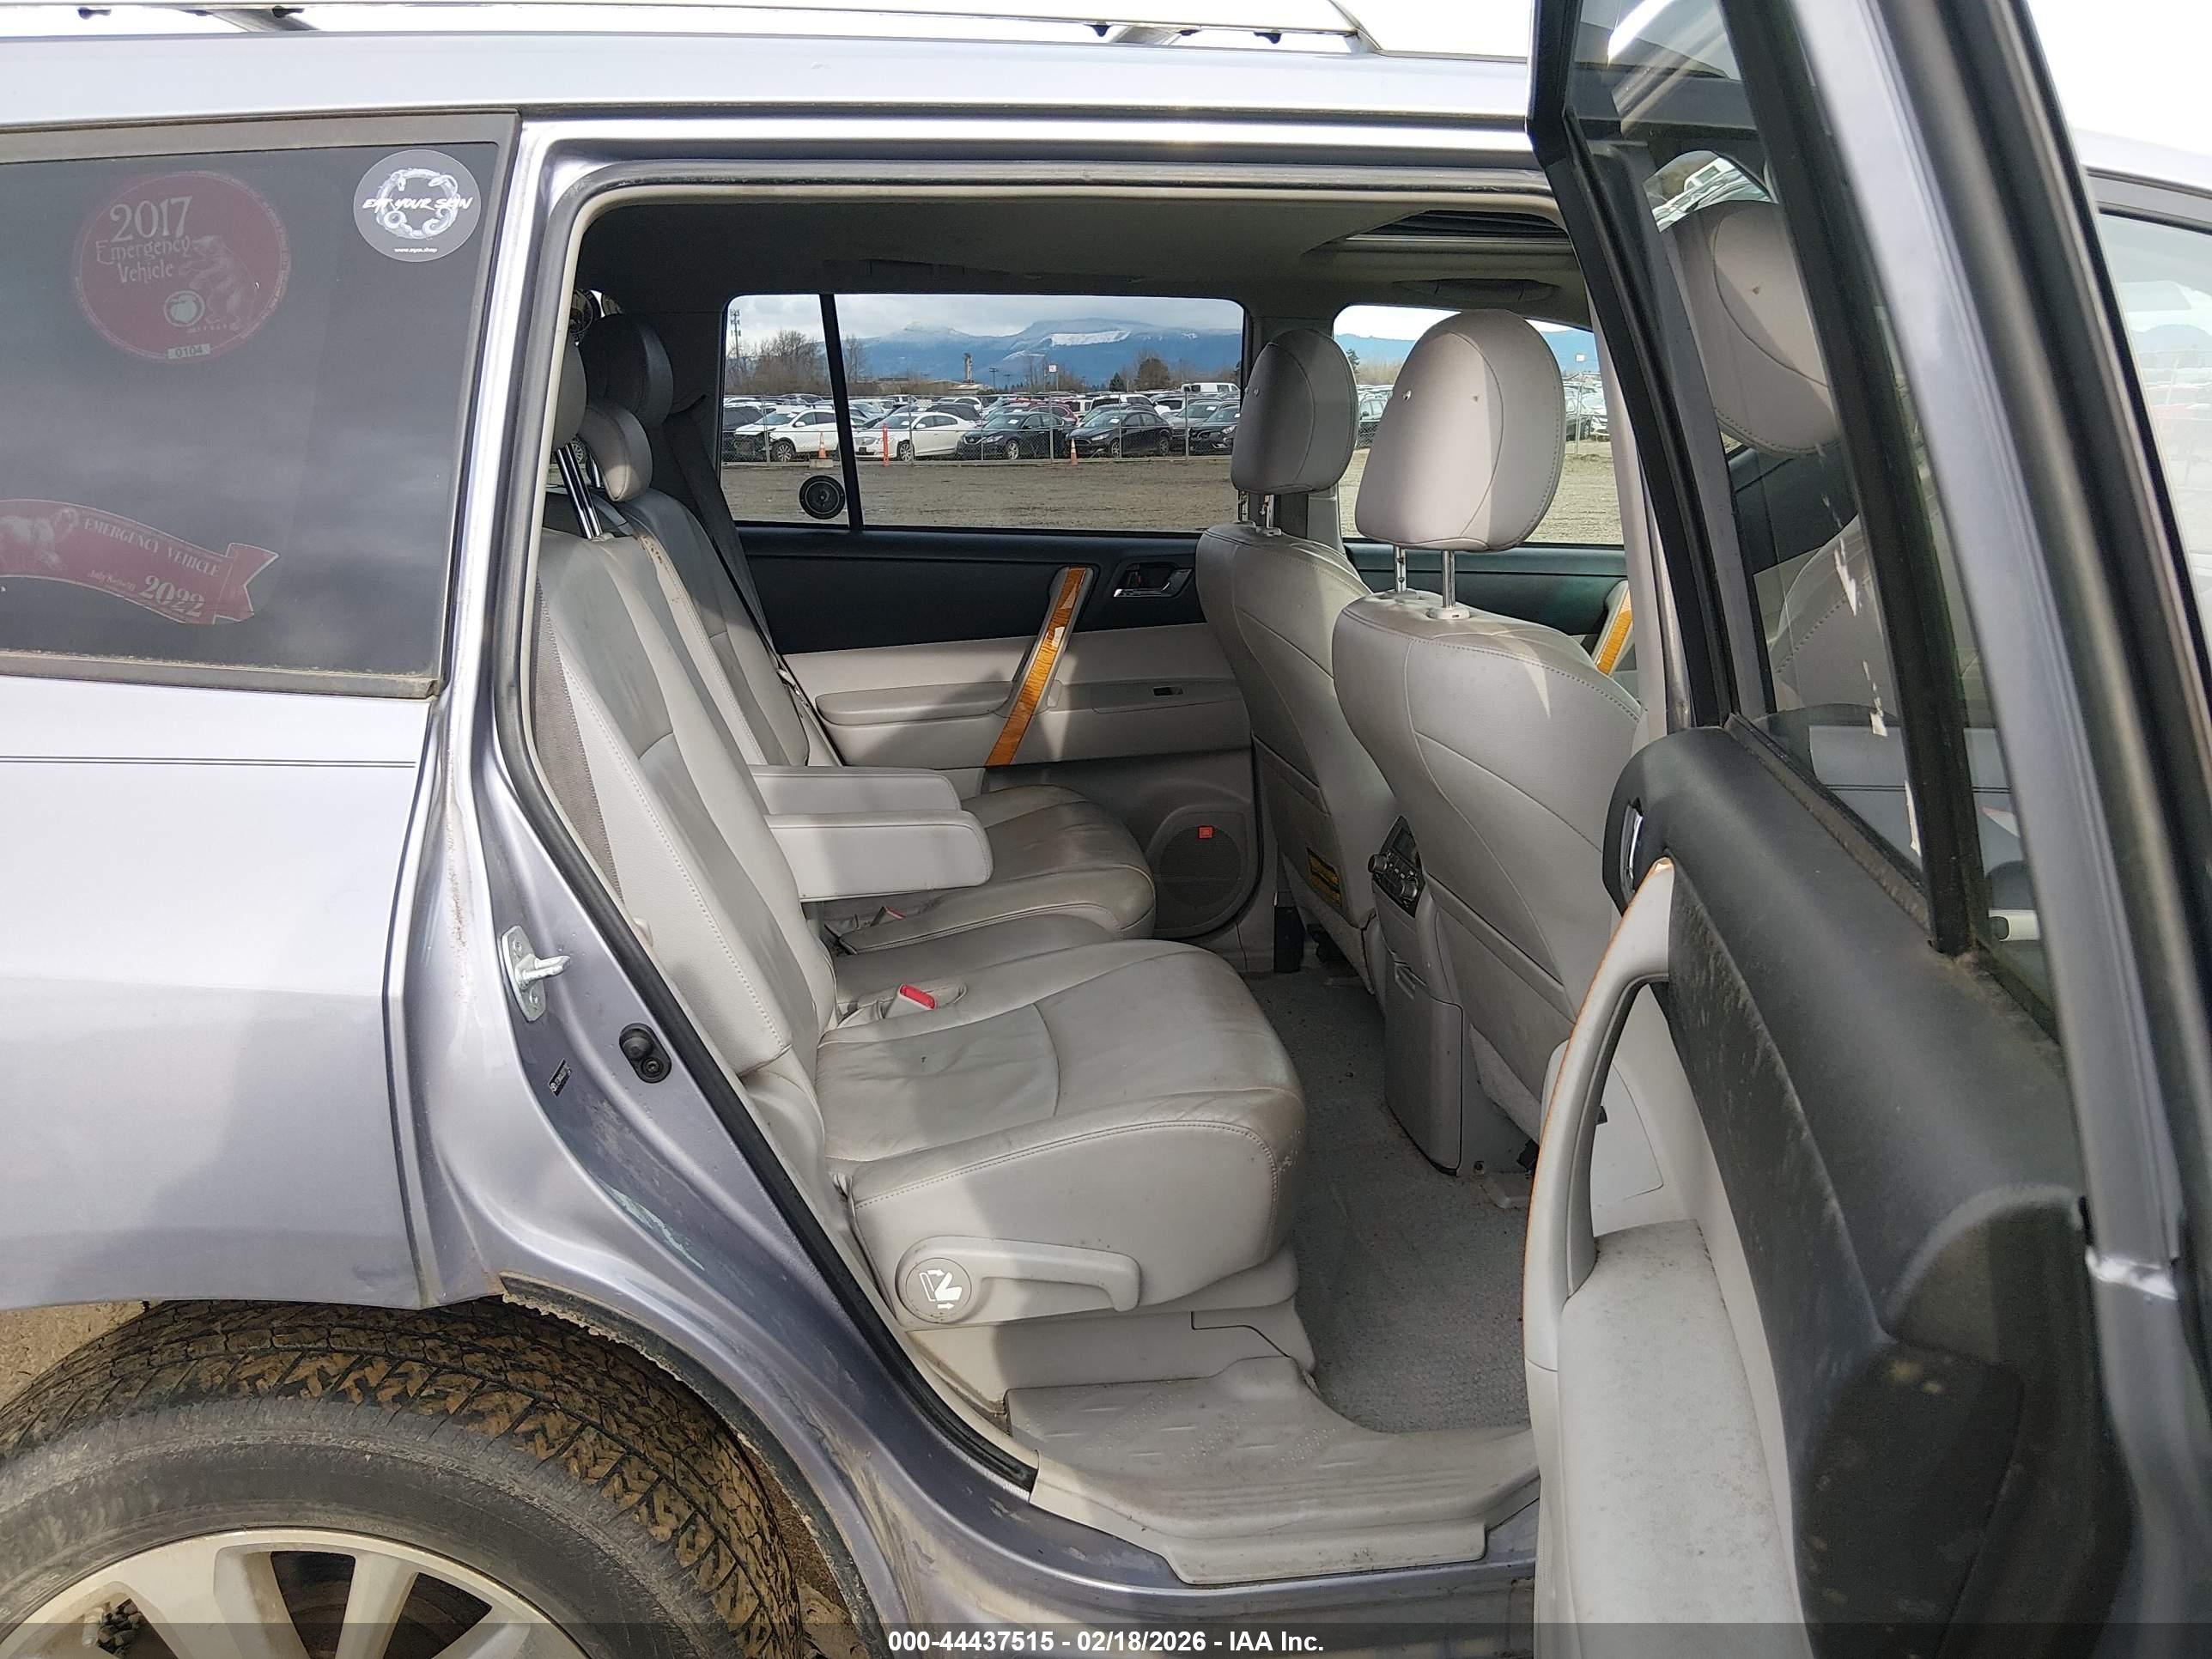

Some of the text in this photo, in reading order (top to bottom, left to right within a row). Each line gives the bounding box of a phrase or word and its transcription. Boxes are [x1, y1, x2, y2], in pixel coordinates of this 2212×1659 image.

[109, 195, 192, 243] 2017
[393, 198, 436, 211] YOUR
[95, 235, 191, 264] Emergency
[117, 258, 173, 283] Vehicle
[175, 346, 204, 358] 0104
[83, 518, 221, 577] EMERGENCY VEHICLE
[138, 575, 205, 617] 2022
